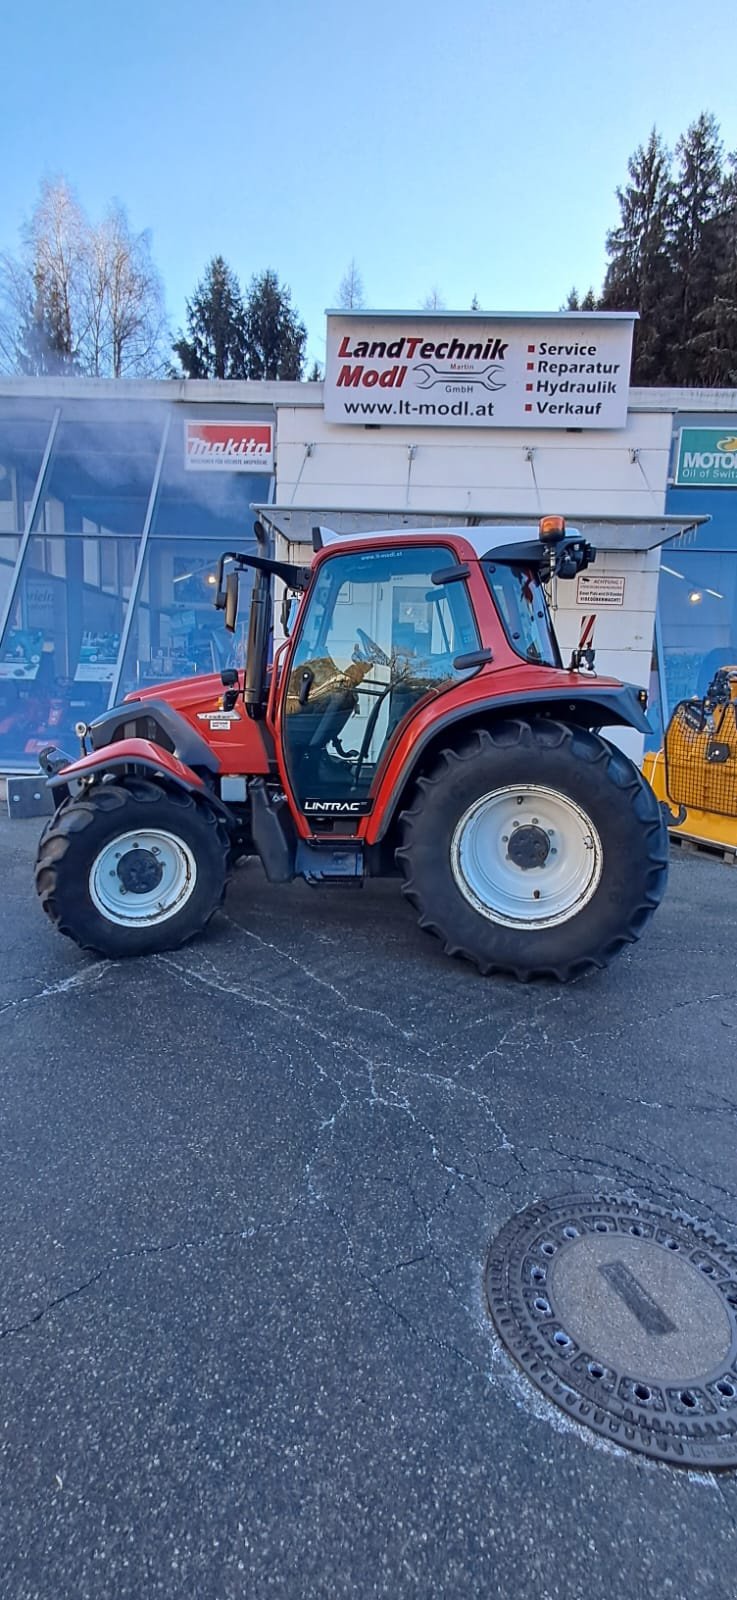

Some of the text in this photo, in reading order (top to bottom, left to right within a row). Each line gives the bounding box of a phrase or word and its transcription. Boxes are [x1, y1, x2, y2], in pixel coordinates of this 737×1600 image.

[337, 336, 509, 360] LandTechnik
[538, 342, 597, 356] Service
[450, 363, 474, 371] Martin
[537, 360, 620, 375] Reparatur
[336, 365, 406, 388] Modl
[445, 384, 474, 393] GmbH
[536, 381, 617, 396] Hydraulik
[344, 400, 495, 417] www.lt-modl.at
[536, 402, 602, 415] Verkauf
[683, 452, 737, 469] MOTO
[682, 469, 696, 477] Oil
[700, 469, 710, 478] of
[304, 802, 360, 811] LINTRAC
